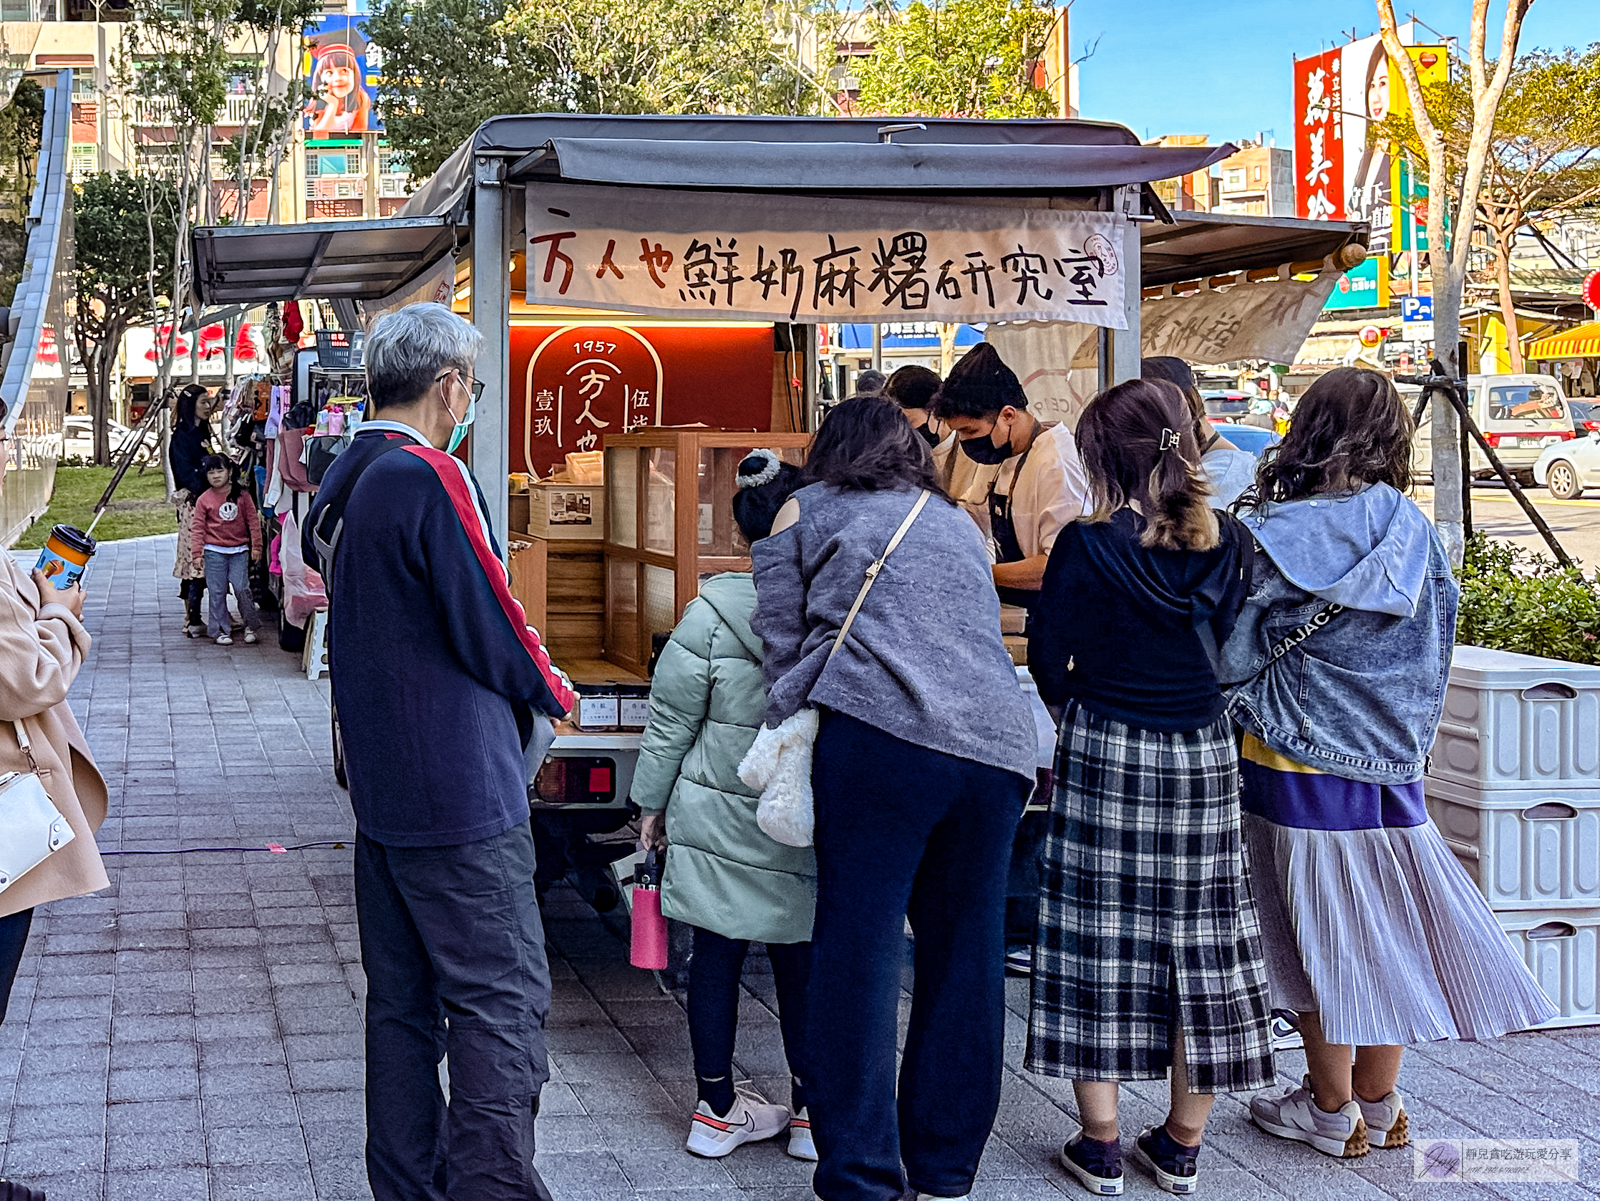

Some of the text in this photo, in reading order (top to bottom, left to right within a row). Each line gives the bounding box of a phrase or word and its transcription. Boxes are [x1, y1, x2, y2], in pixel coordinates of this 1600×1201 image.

[1405, 299, 1420, 316] P
[573, 340, 617, 355] 1957
[534, 389, 555, 437] 壹玖
